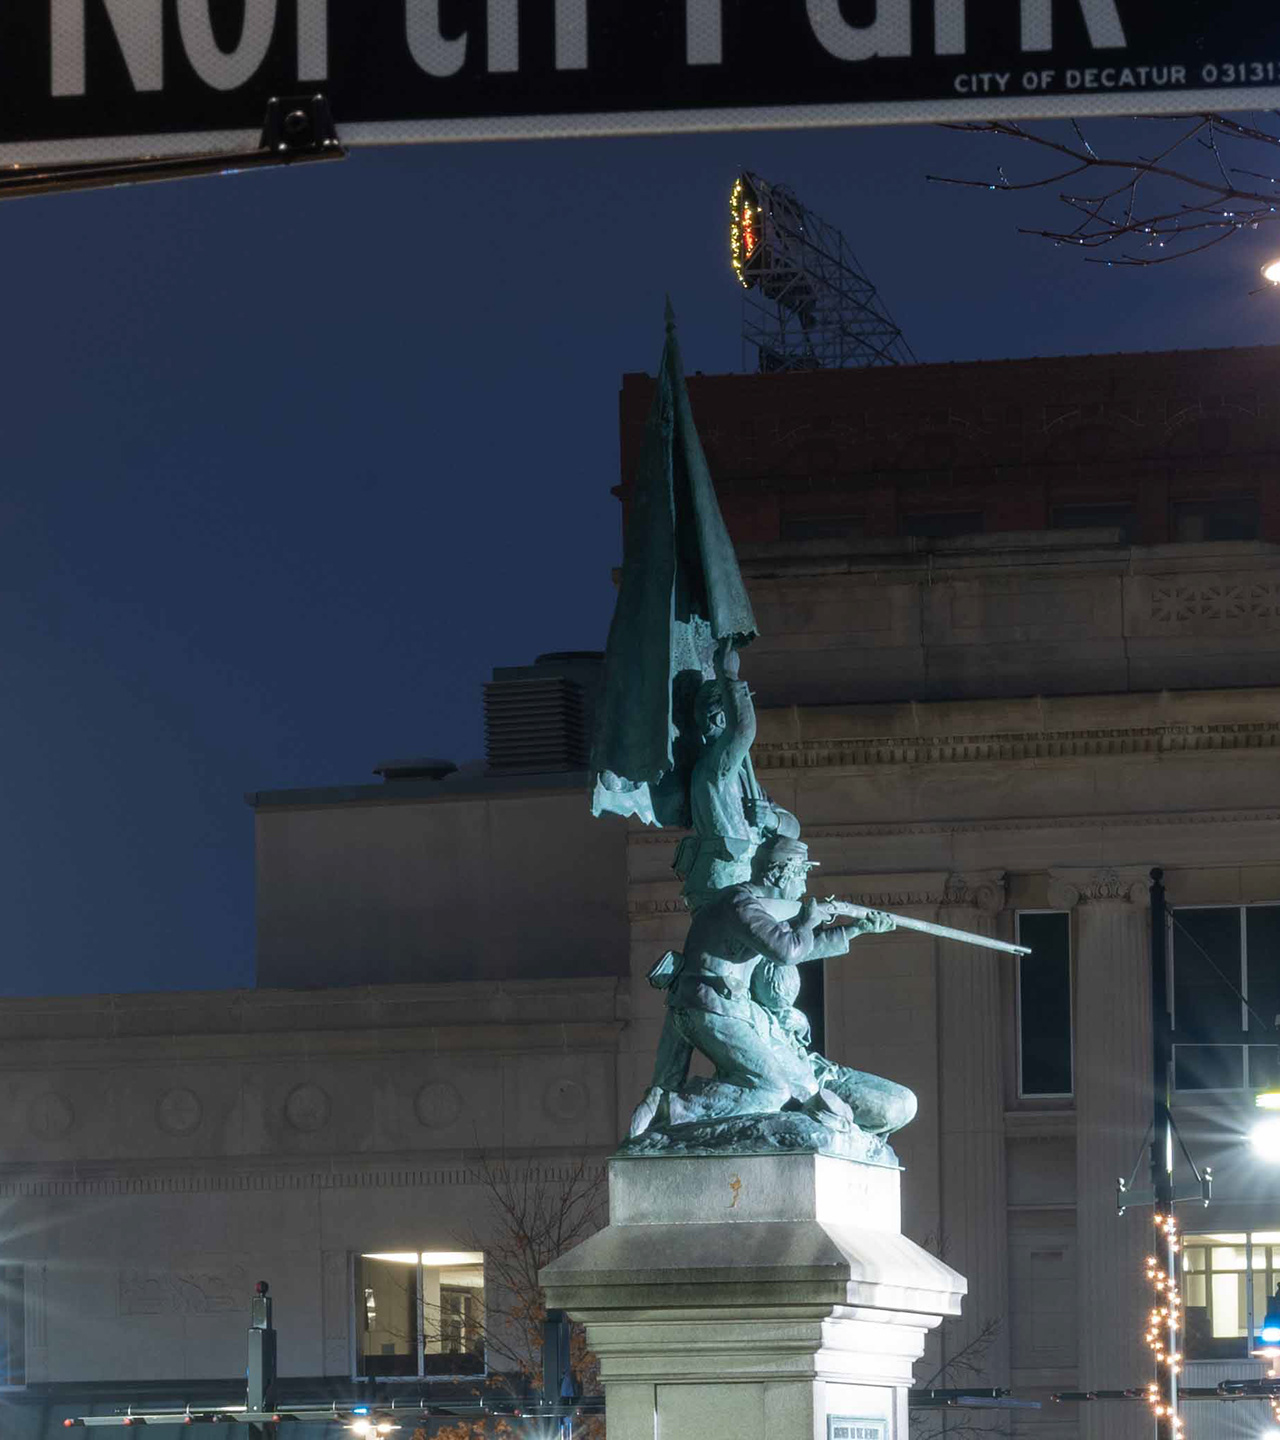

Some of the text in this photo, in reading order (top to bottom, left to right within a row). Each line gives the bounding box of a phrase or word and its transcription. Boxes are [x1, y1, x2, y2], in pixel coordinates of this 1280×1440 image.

[953, 72, 1011, 93] CITY
[1022, 70, 1057, 90] OF
[1065, 65, 1187, 90] DECATUR
